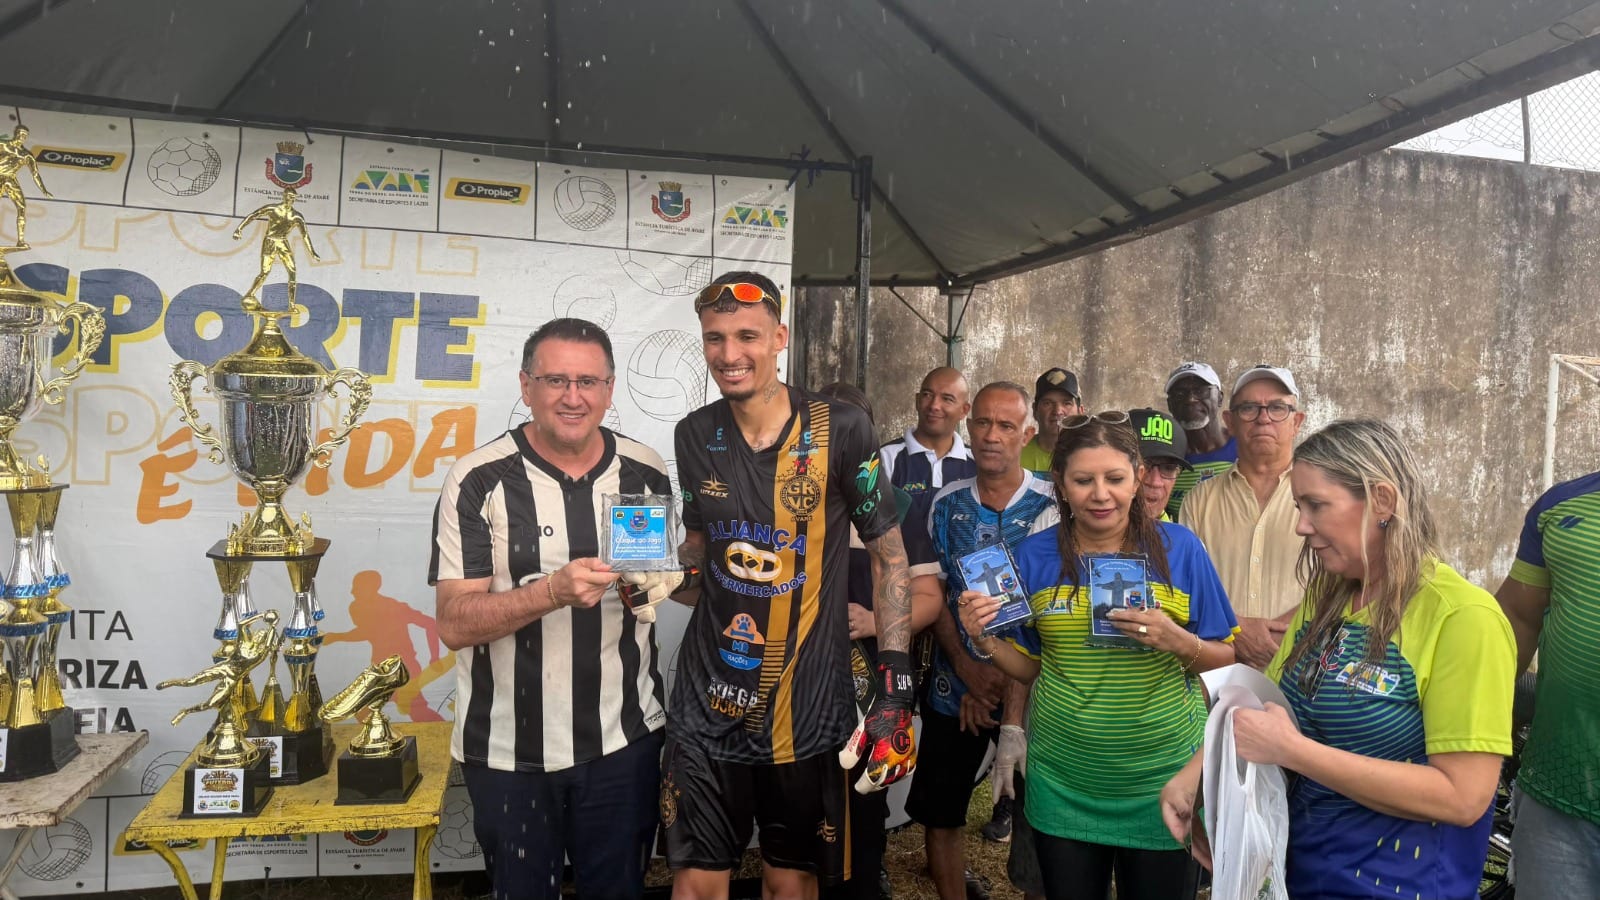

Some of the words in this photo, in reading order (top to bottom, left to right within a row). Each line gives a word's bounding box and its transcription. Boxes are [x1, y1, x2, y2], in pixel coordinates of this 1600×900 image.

[63, 154, 105, 166] Proplac
[477, 185, 514, 198] Proplac
[1141, 414, 1173, 440] JÃO
[136, 426, 198, 524] É
[237, 406, 476, 506] IDA
[708, 519, 807, 556] ALIANÇA
[711, 559, 807, 598] SUPERMERCADOS
[69, 610, 134, 641] ITA
[58, 658, 149, 690] RIZA
